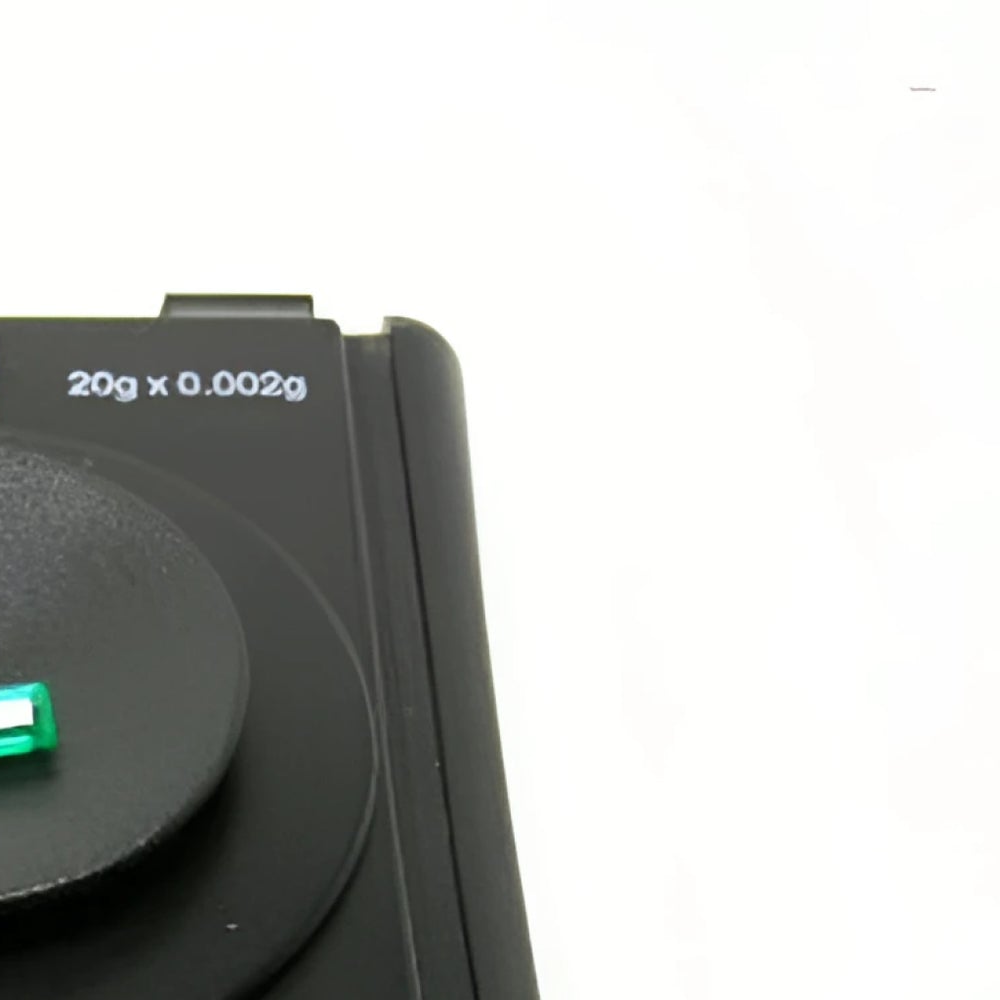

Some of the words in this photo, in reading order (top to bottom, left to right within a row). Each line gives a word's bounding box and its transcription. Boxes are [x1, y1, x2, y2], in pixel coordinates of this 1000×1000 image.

[67, 370, 138, 402] 20g
[147, 375, 169, 396] x
[177, 370, 307, 402] 0.002g
